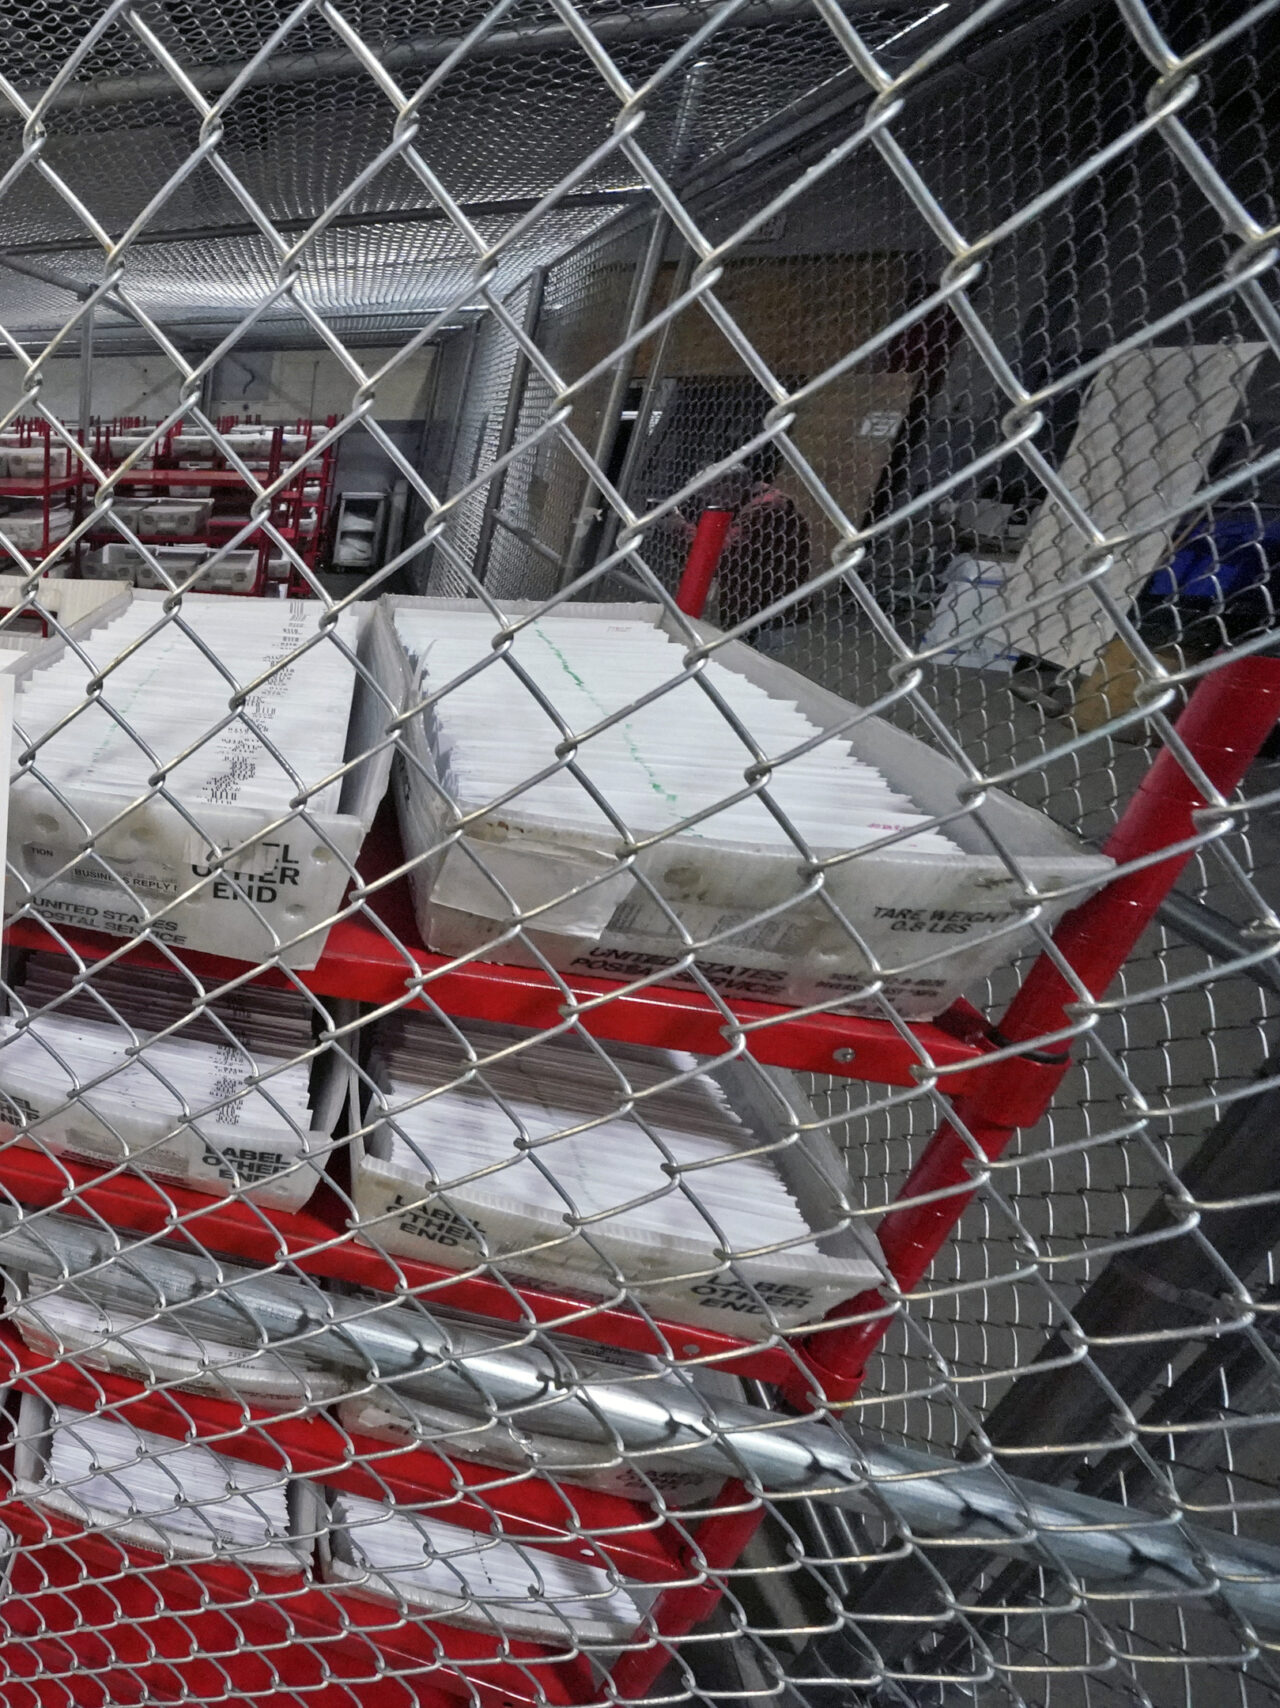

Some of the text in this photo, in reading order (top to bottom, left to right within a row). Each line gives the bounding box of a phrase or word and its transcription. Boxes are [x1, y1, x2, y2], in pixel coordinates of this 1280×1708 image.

[74, 868, 171, 891] BUSINS REPLY
[213, 881, 277, 904] END
[32, 896, 178, 932] UNITED STAES
[873, 906, 1014, 924] TARE WEIGHT
[32, 907, 187, 945] OSTAL SERICE
[570, 957, 656, 976] POSTA
[400, 1222, 458, 1246] END
